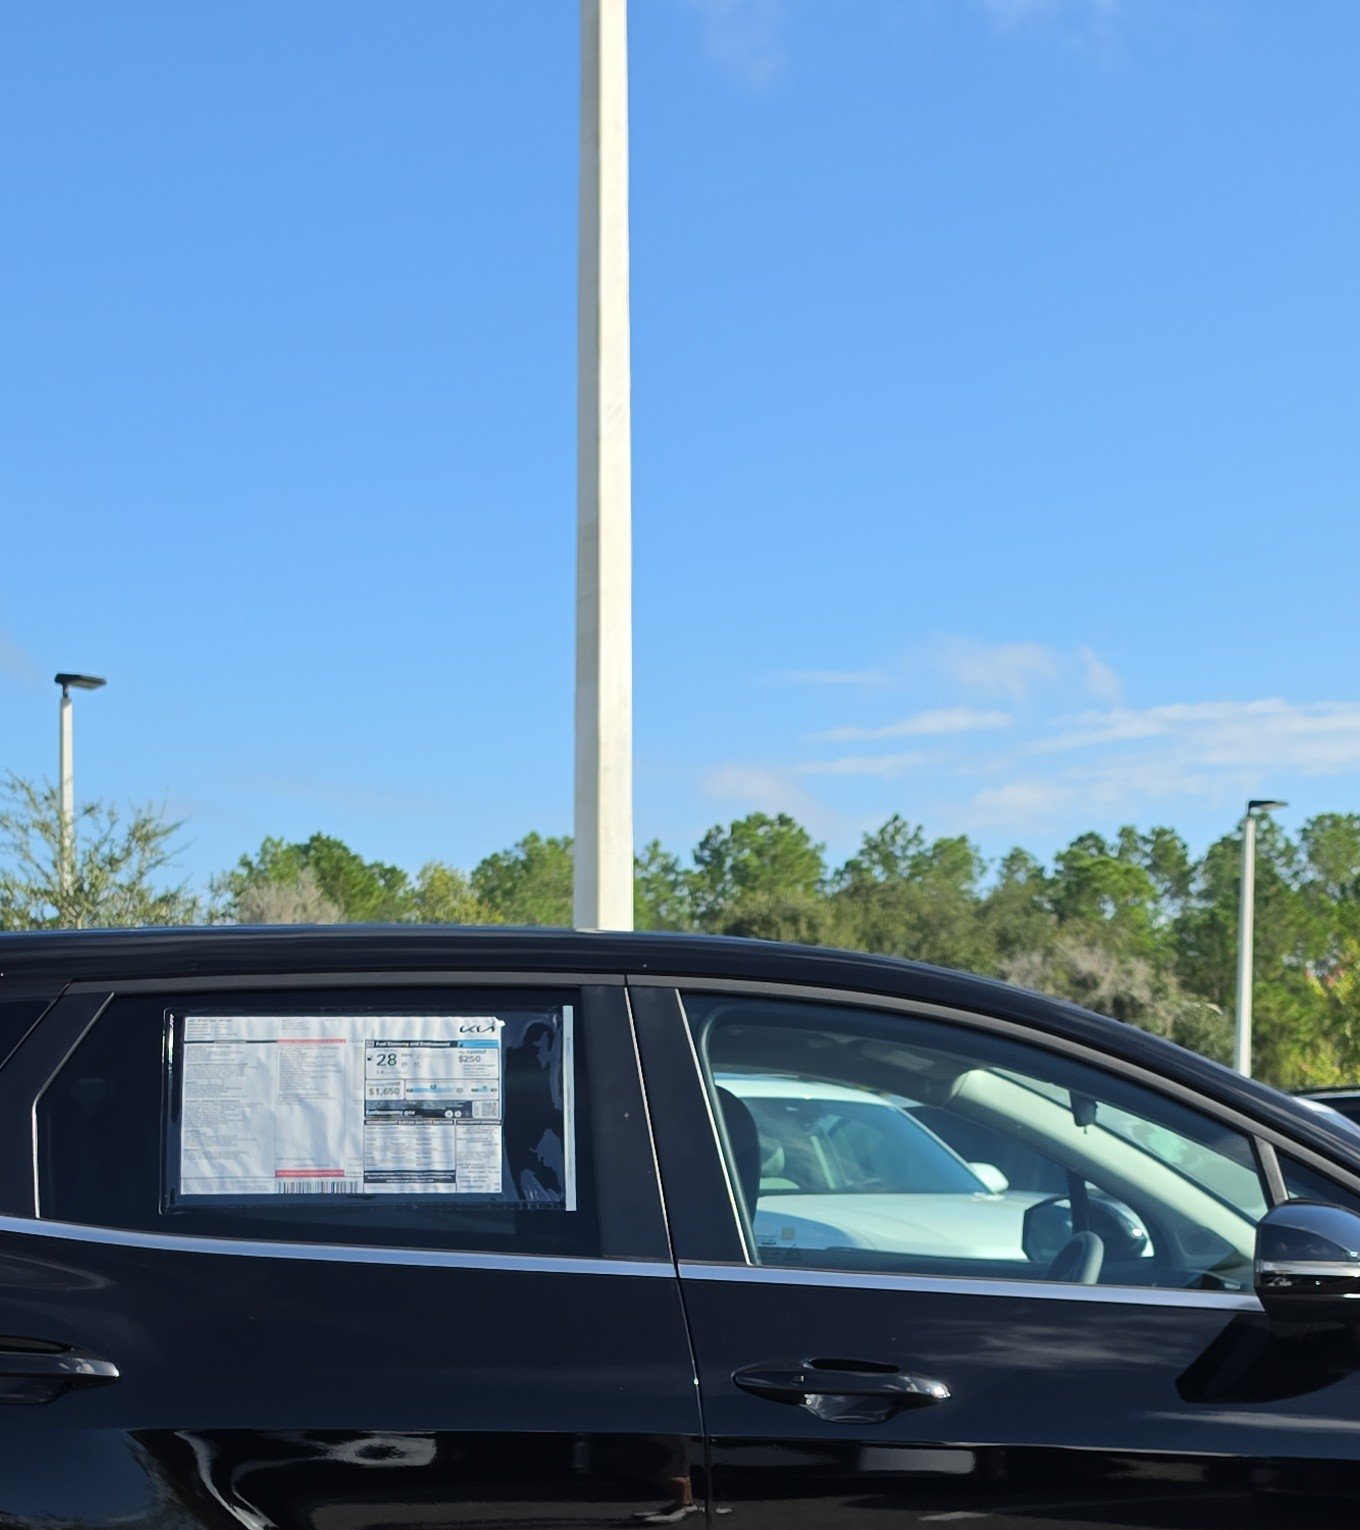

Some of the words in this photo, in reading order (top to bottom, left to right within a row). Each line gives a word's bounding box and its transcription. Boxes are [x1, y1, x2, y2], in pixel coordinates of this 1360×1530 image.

[460, 1025, 495, 1034] KIA
[376, 1053, 397, 1067] 28
[458, 1055, 482, 1063] $250
